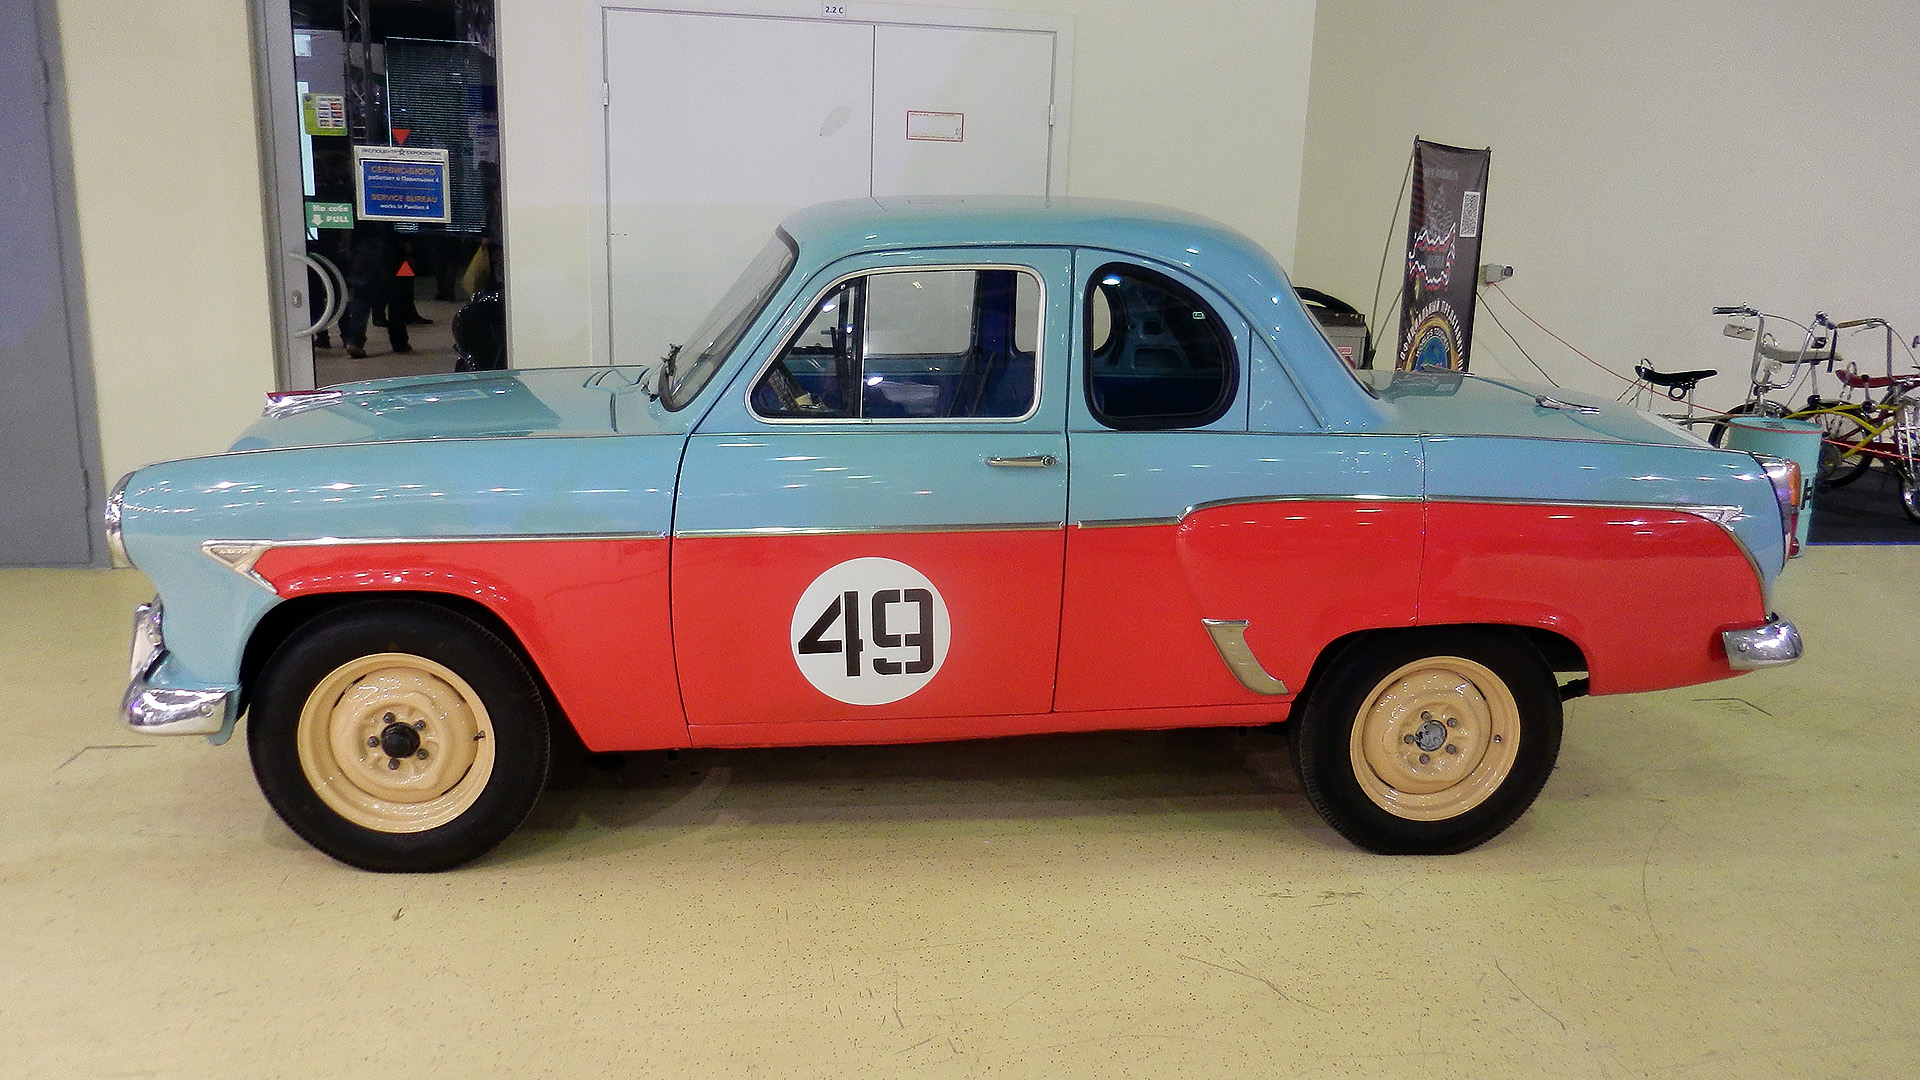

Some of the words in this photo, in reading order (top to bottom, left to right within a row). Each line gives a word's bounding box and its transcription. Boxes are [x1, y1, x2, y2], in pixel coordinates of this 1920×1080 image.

[371, 165, 436, 175] СЕРВИС-БЮРО
[371, 193, 403, 201] SERVICE
[405, 195, 438, 203] BUREAU
[326, 215, 350, 223] PULL
[798, 588, 934, 677] 49
